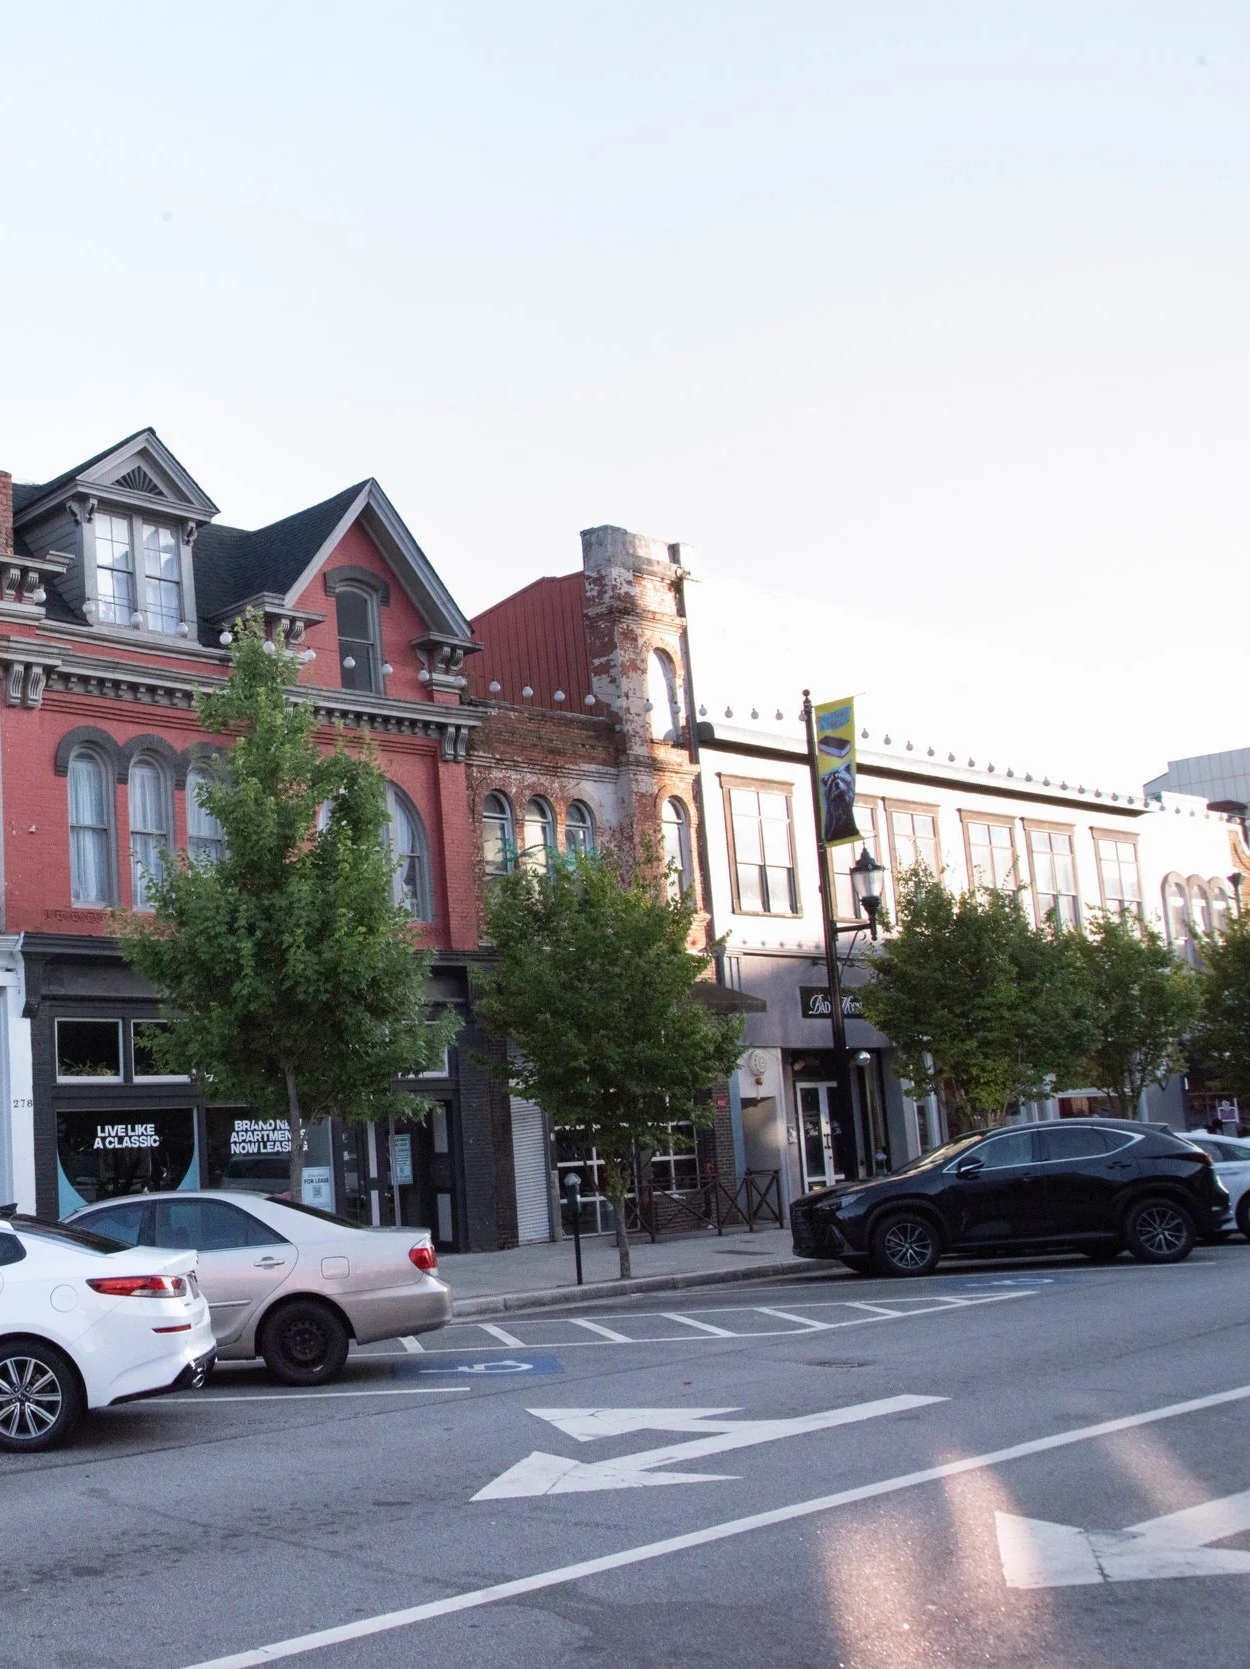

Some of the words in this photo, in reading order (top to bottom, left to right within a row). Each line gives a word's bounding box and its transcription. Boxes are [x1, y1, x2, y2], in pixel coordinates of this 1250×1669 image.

[13, 1098, 33, 1108] 278
[97, 1125, 126, 1137] LIVE
[127, 1123, 155, 1136] LIKE
[234, 1119, 275, 1131] BRAND
[93, 1137, 104, 1149] A
[105, 1135, 160, 1149] CLASSIC
[230, 1129, 307, 1142] APARTMENS
[231, 1142, 258, 1154] NOW
[260, 1140, 309, 1153] LEASIG
